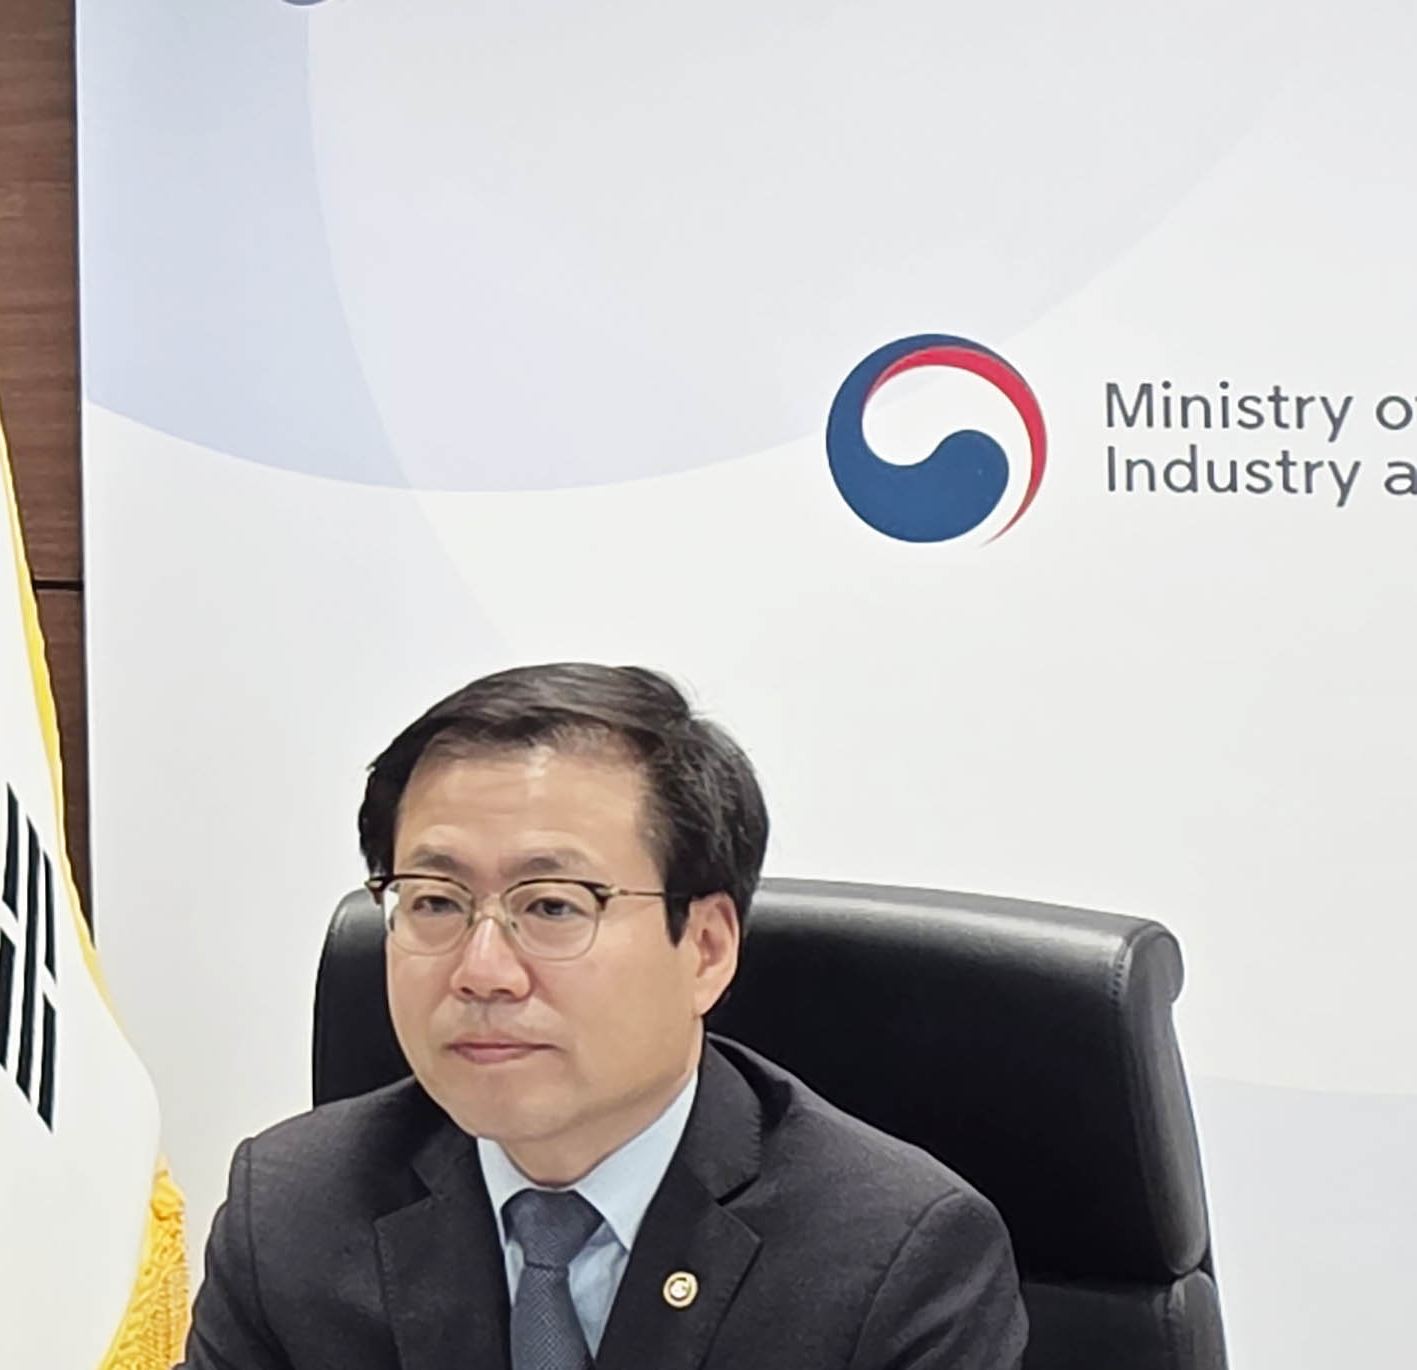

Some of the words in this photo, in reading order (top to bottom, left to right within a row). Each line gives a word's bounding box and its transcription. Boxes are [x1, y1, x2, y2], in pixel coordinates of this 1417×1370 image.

[1106, 380, 1353, 443] Ministry
[1375, 394, 1417, 431] o
[1107, 443, 1361, 508] Industry
